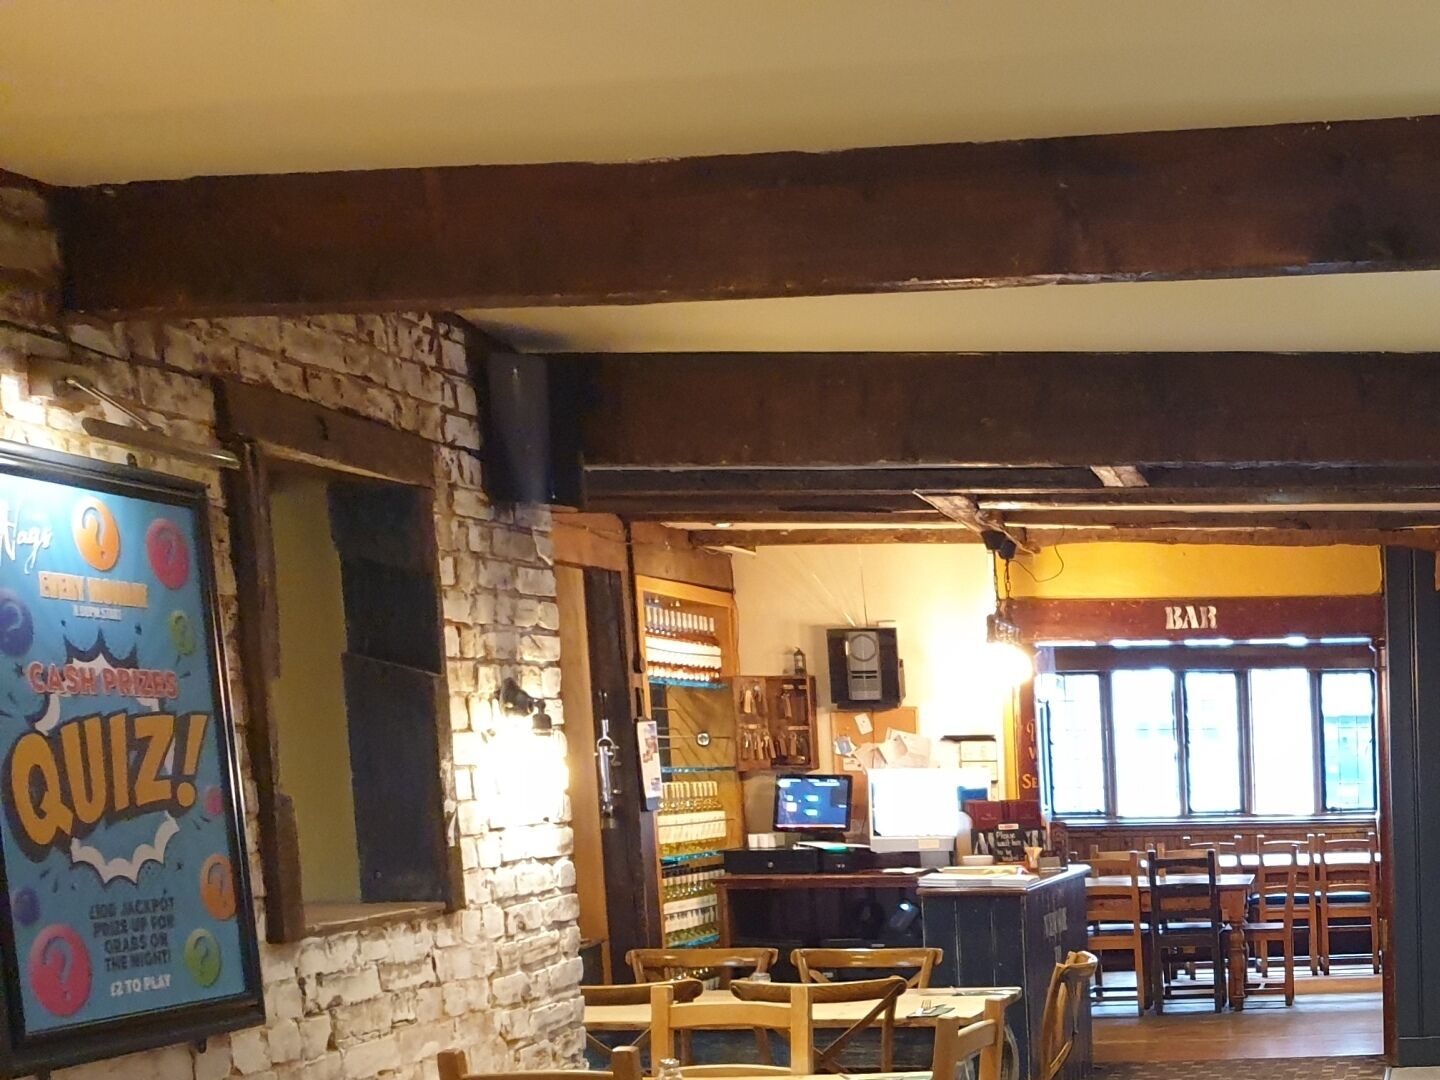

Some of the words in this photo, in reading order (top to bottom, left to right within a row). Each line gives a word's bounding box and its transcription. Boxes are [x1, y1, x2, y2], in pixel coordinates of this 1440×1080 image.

[1164, 605, 1218, 630] BAR
[27, 661, 99, 696] CASH
[101, 667, 179, 699] PRIZES
[11, 712, 208, 846] QUIZ!
[121, 898, 174, 916] JACKPOT
[93, 919, 128, 938] PRIZE
[150, 913, 175, 931] FOR
[104, 935, 146, 954] GRABS
[104, 955, 128, 972] THE
[124, 978, 142, 995] TO
[142, 974, 171, 991] PLAY
